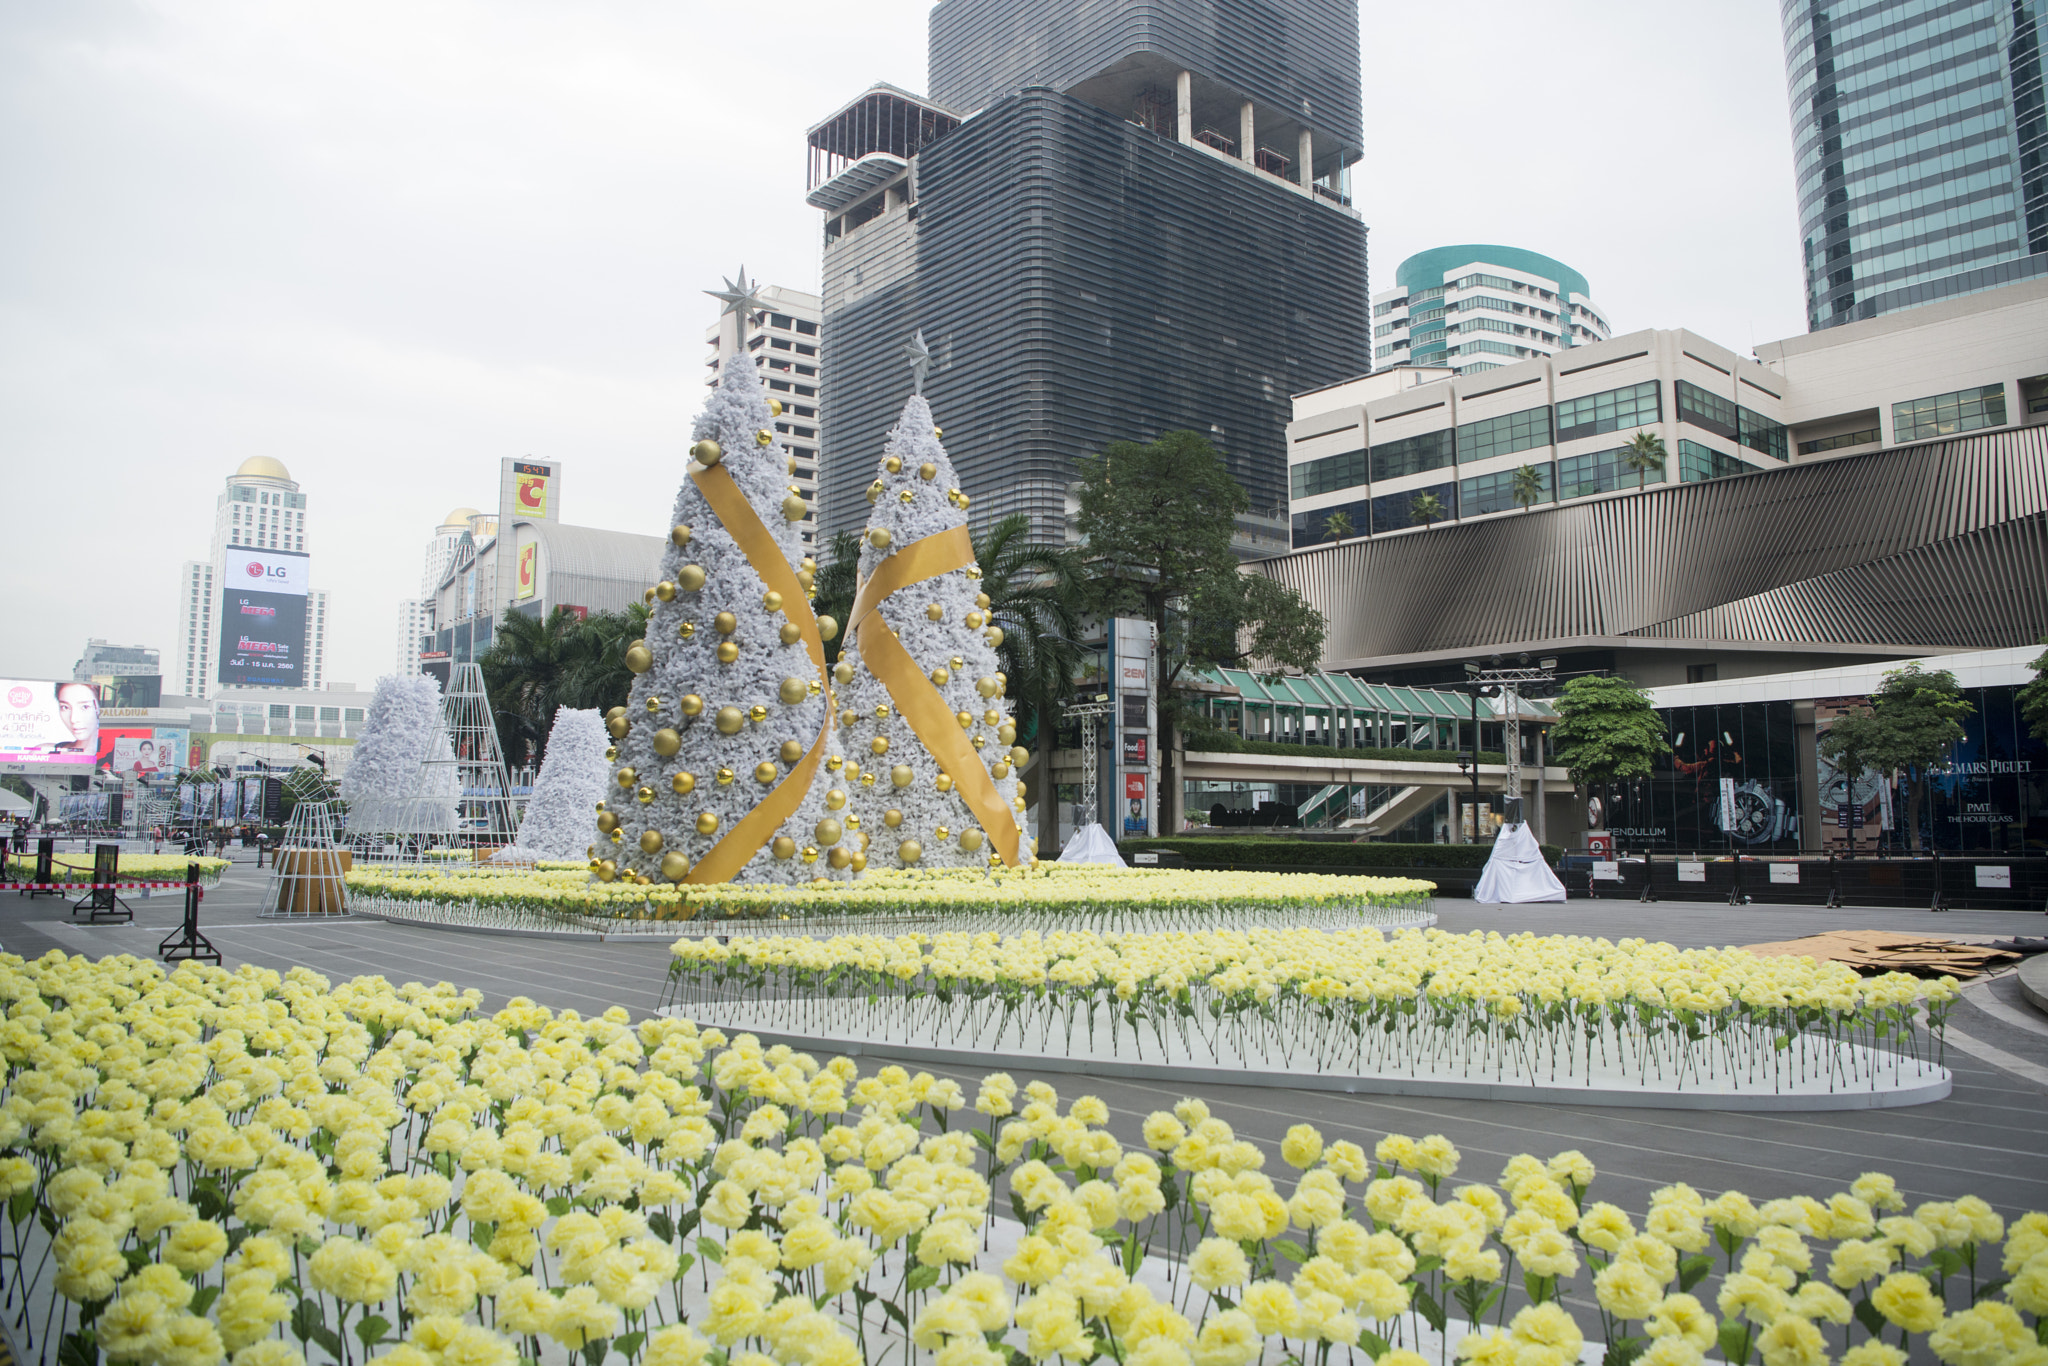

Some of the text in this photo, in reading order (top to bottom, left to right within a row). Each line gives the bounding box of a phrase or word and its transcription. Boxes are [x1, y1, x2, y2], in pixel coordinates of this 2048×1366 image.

[266, 565, 287, 578] LG
[241, 605, 276, 617] MEGA
[238, 640, 277, 653] MEGA
[1124, 667, 1146, 679] ZEN
[10, 691, 31, 699] Cathy
[12, 697, 27, 705] Doll
[99, 708, 149, 717] PALLADIUM
[17, 754, 51, 762] KARMART
[1990, 760, 2032, 773] PIGUET
[1967, 803, 1991, 813] PMT
[1963, 815, 1987, 823] HOUR
[1988, 815, 2014, 823] GLASS
[1605, 828, 1667, 836] PENDULUM
[1594, 842, 1601, 853] P
